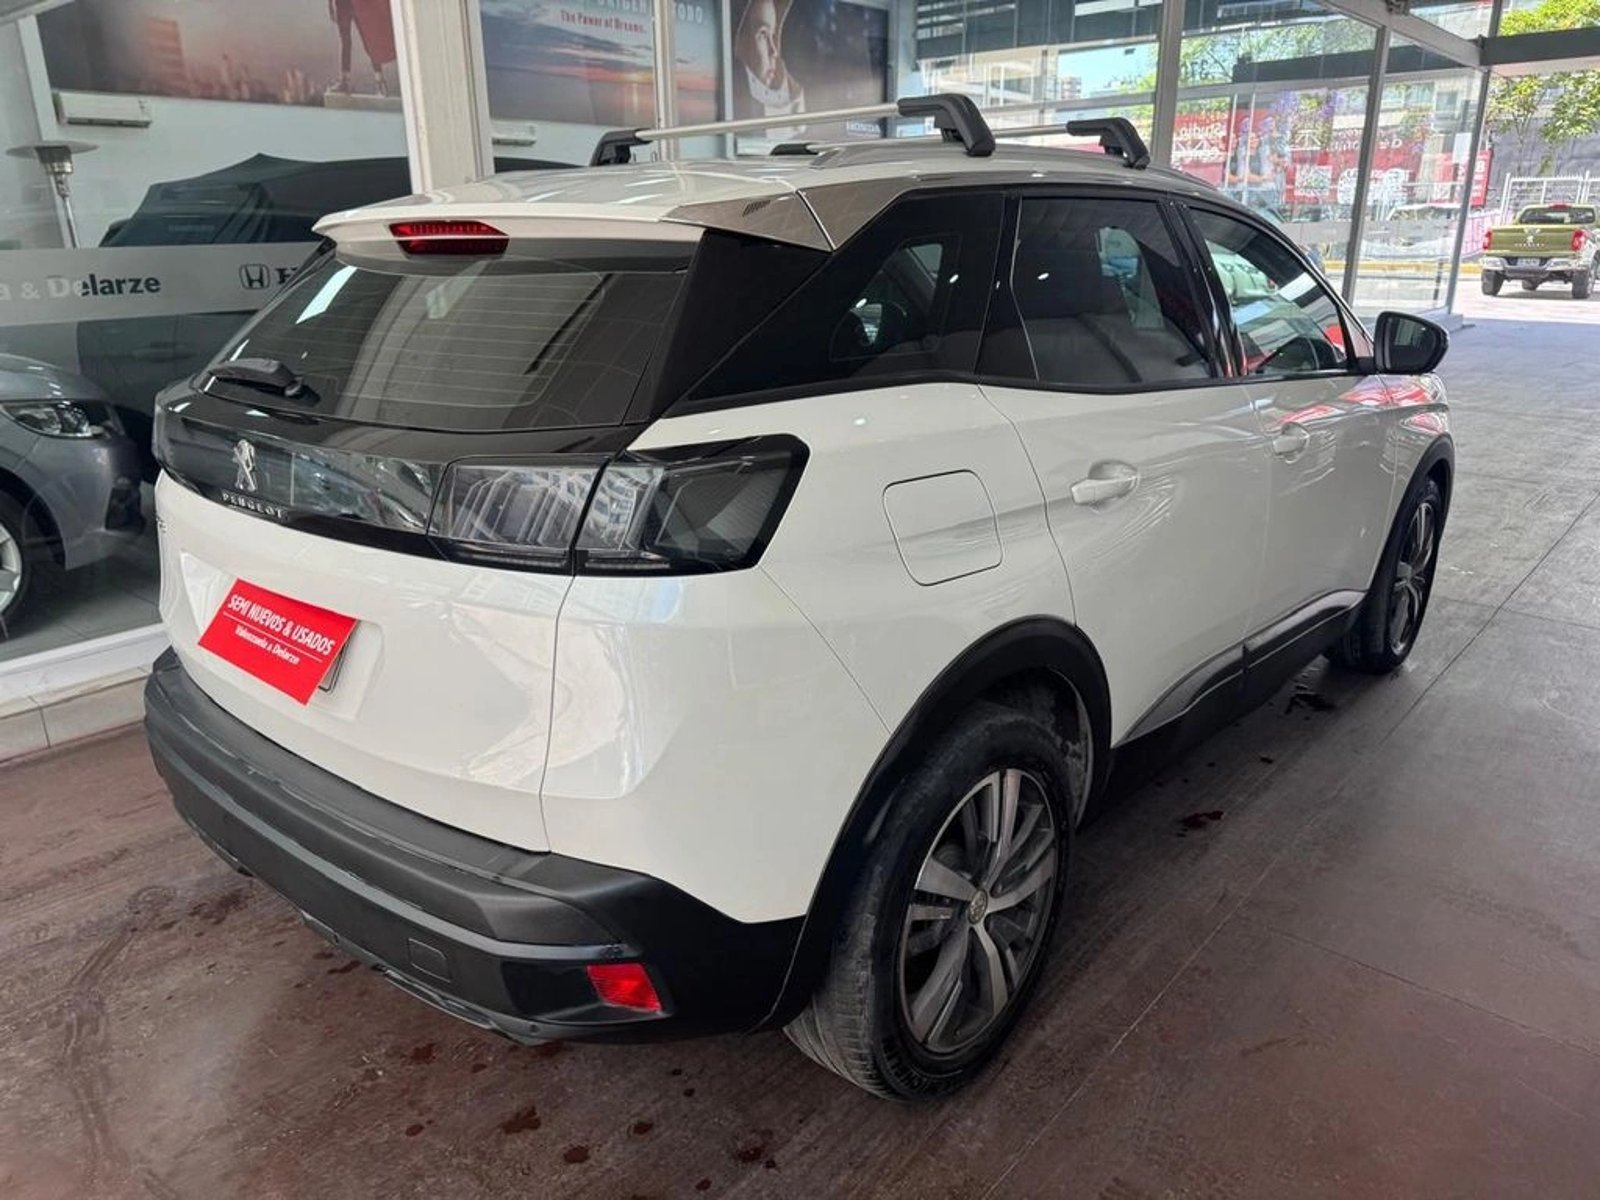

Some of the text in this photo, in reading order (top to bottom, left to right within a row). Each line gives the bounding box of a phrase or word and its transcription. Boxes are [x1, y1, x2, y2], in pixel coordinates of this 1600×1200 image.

[47, 273, 161, 298] Delarze
[228, 594, 335, 656] SEMI NUEVOS & USADOS
